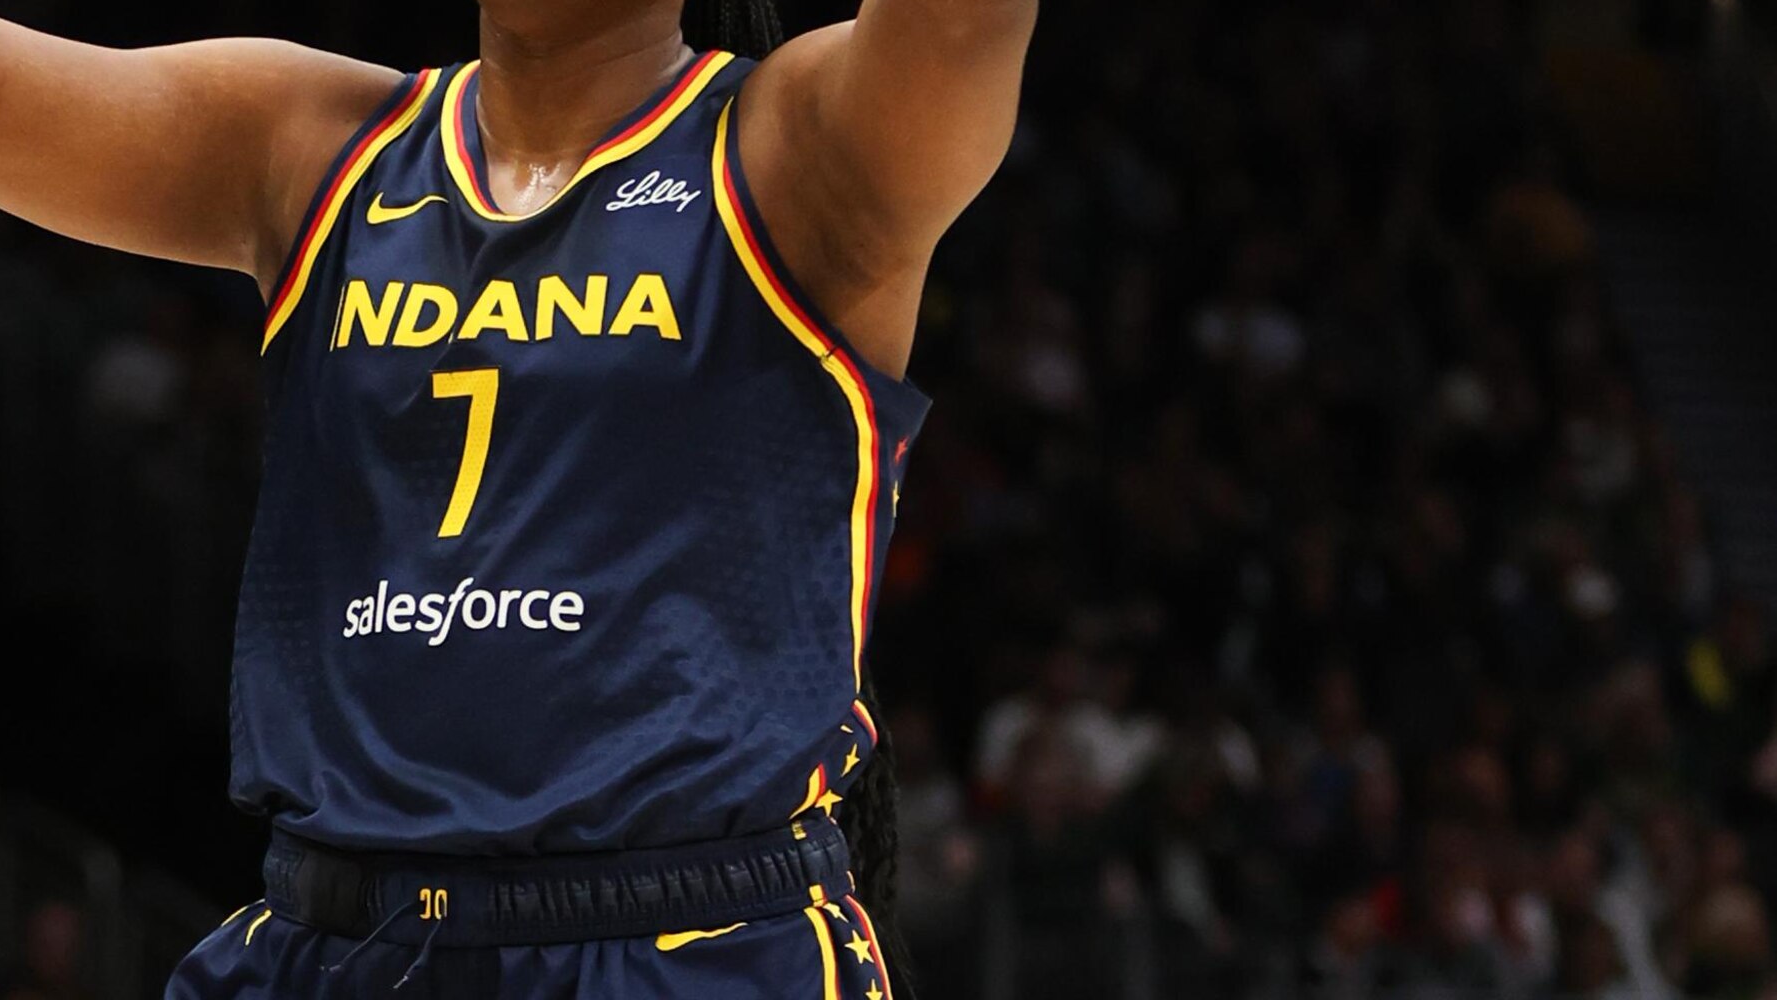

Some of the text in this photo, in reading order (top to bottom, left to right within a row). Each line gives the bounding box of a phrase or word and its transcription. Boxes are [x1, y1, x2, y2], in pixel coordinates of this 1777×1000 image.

[605, 170, 701, 212] Lilly
[432, 368, 499, 538] 7
[343, 577, 584, 646] salesforce
